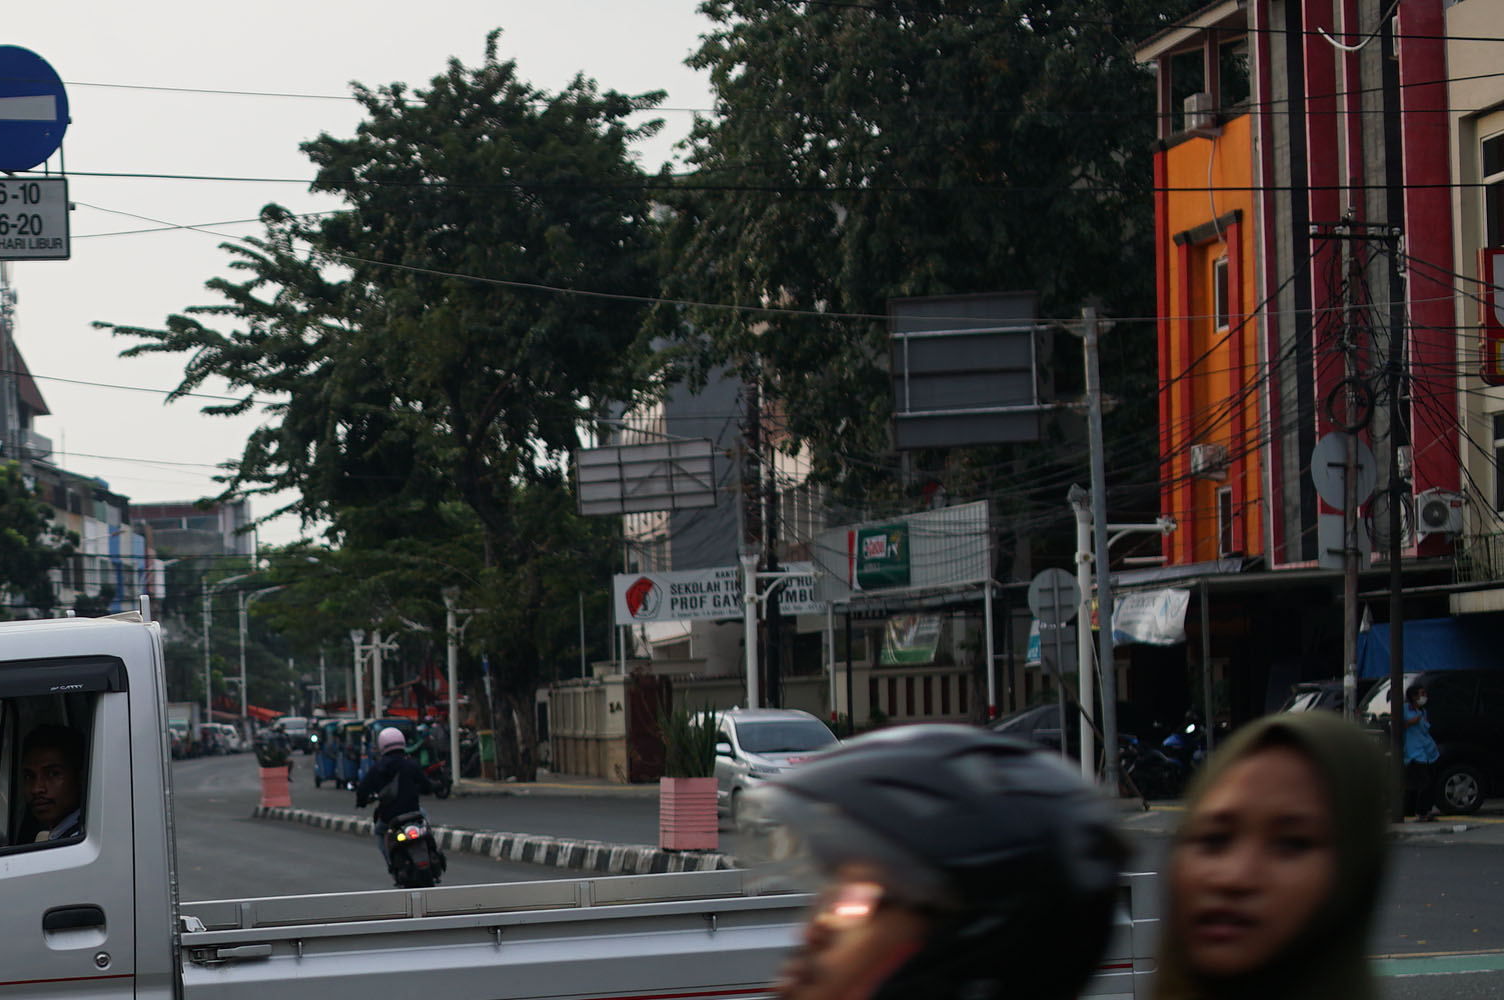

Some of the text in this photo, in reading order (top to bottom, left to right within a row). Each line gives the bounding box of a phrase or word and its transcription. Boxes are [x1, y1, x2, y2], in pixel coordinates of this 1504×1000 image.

[29, 237, 64, 250] LIBUR
[670, 580, 721, 595] SEKOLAH
[670, 595, 707, 610] PROF
